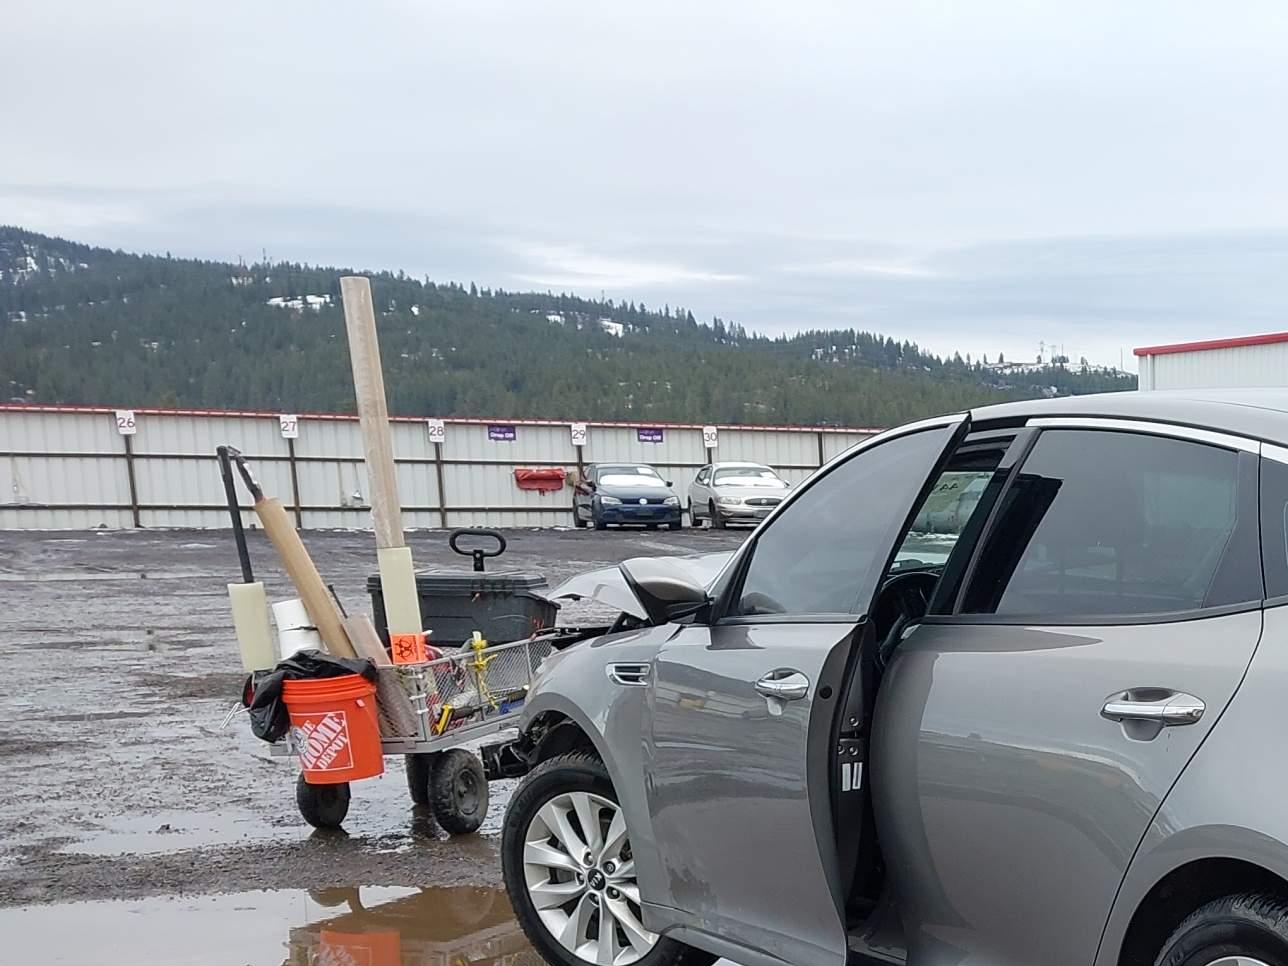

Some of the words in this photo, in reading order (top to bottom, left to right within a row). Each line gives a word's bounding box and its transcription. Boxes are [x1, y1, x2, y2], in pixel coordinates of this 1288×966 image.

[118, 417, 136, 428] 26
[281, 421, 297, 432] 27
[429, 426, 444, 437] 28
[572, 429, 586, 440] 29
[704, 432, 718, 442] 30
[316, 732, 348, 769] DEPOT
